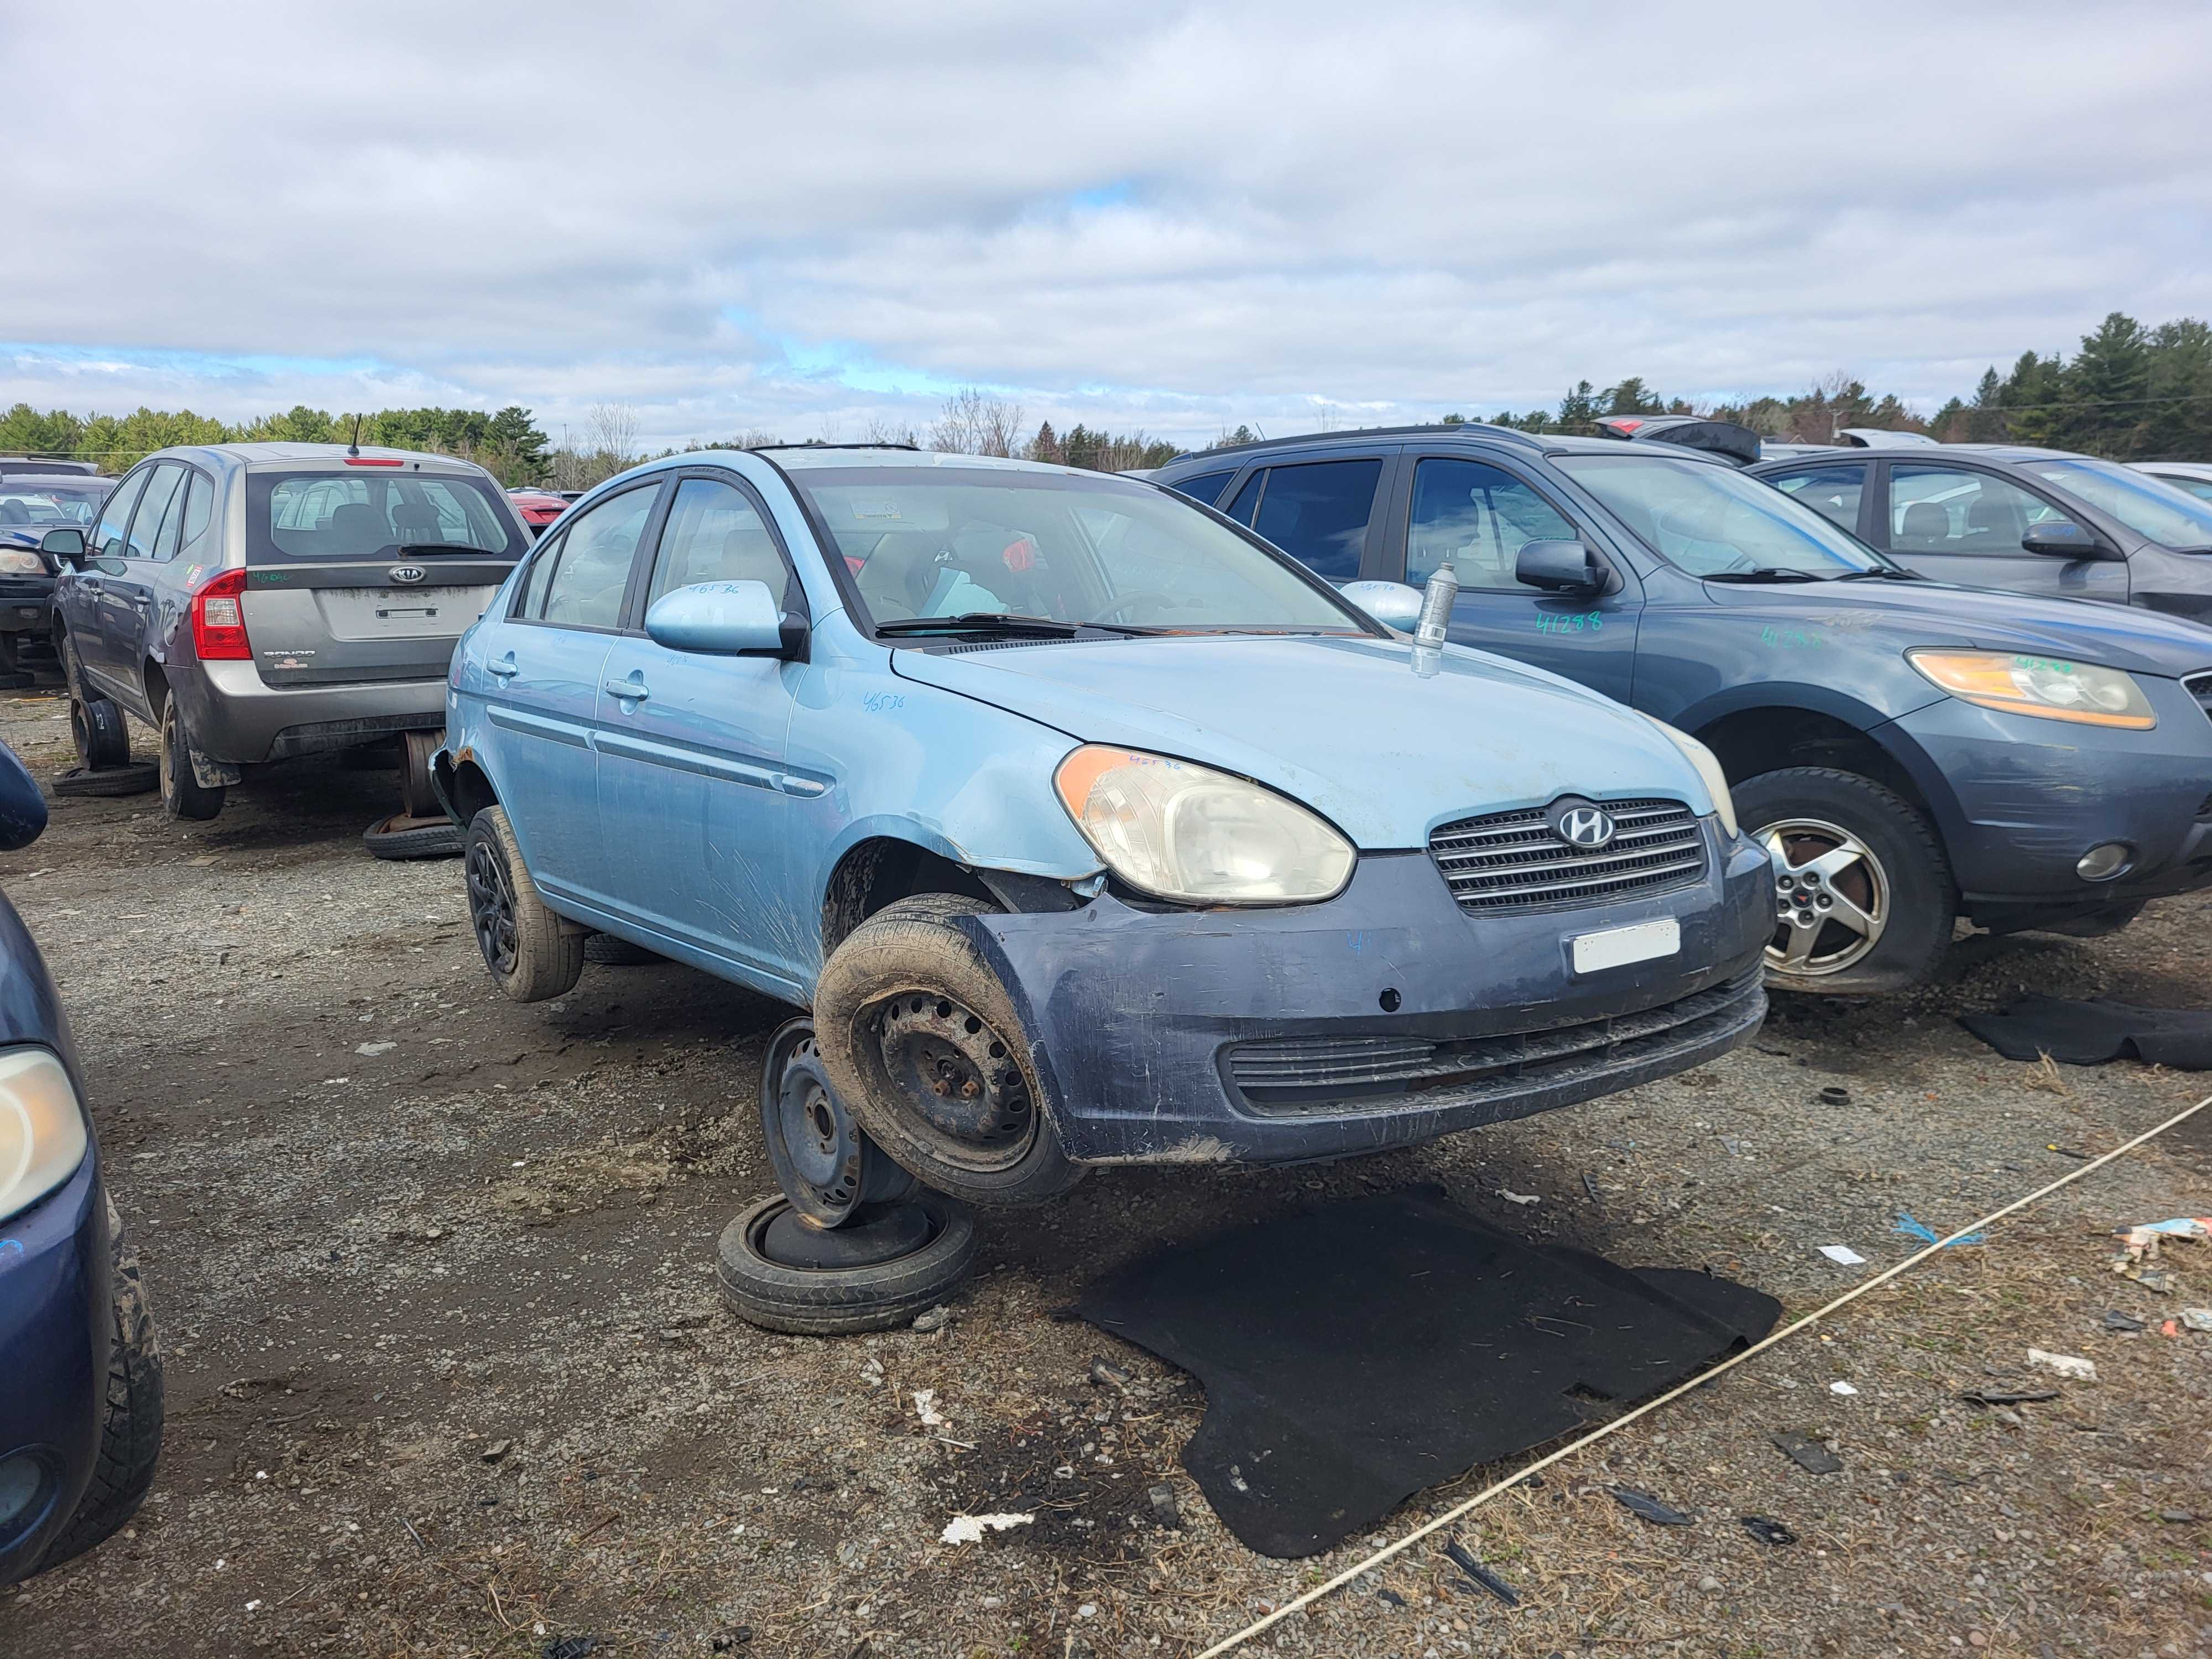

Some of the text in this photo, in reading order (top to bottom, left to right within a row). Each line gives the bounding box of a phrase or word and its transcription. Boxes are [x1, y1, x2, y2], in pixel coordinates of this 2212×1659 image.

[398, 570, 419, 580] KIA
[1536, 611, 1603, 635] 41288
[863, 691, 906, 712] 46536
